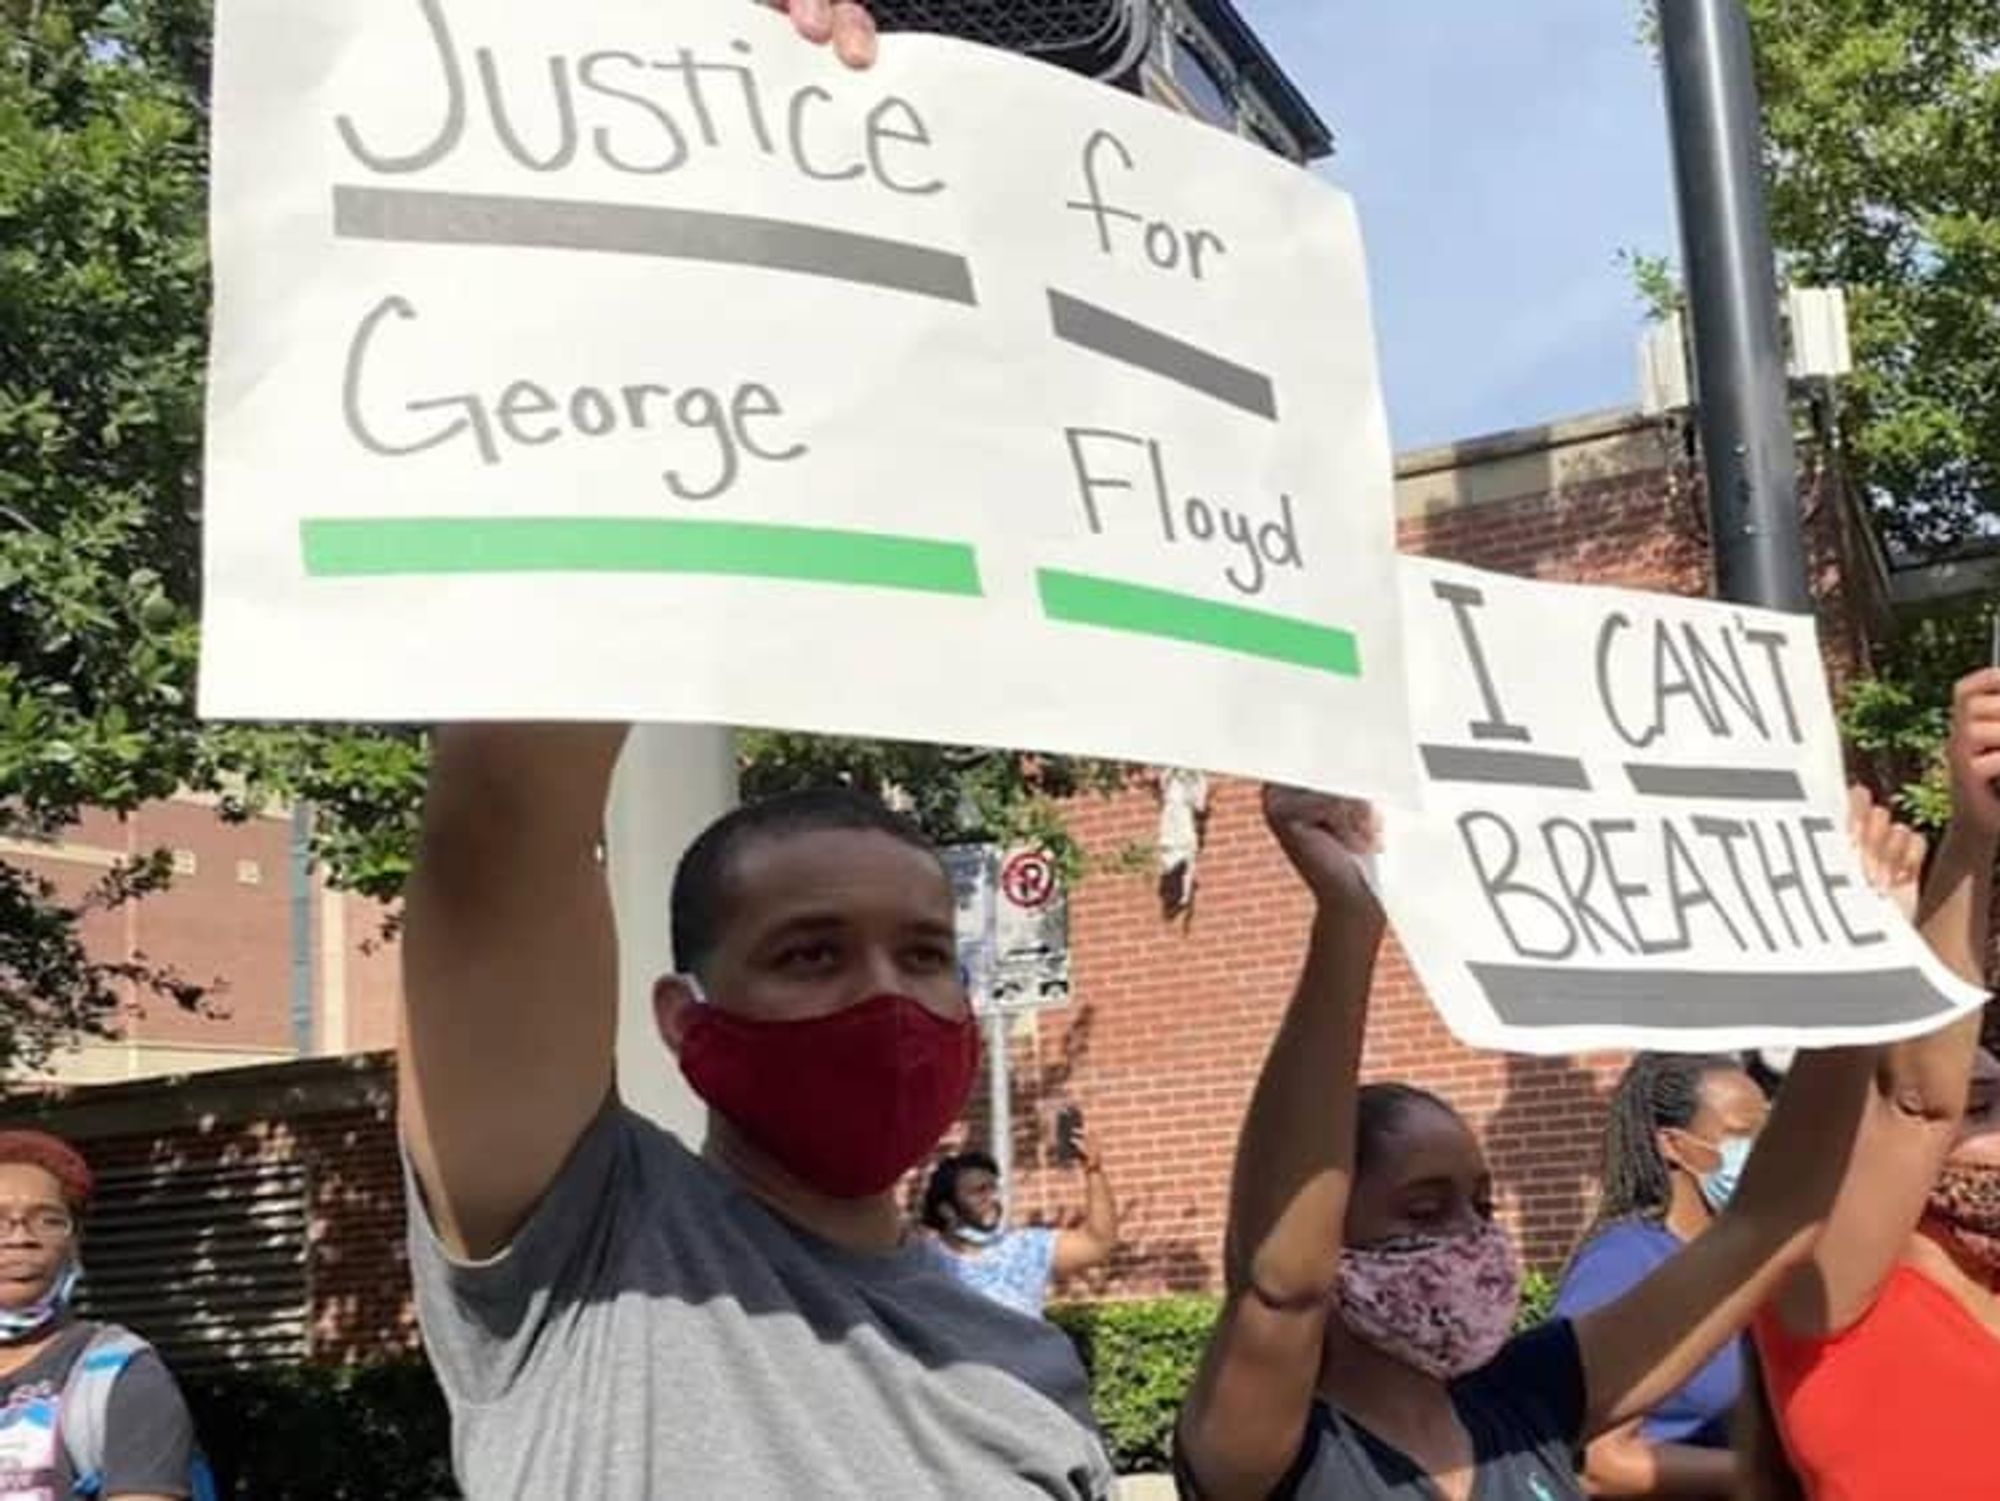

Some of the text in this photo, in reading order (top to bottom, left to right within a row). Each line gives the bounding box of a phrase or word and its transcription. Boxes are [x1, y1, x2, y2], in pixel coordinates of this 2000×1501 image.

[335, 0, 1227, 280] Justice for
[341, 295, 1304, 595] George Floyd
[1431, 580, 1804, 748] I CAN'T
[1456, 810, 1888, 961] BREATHE
